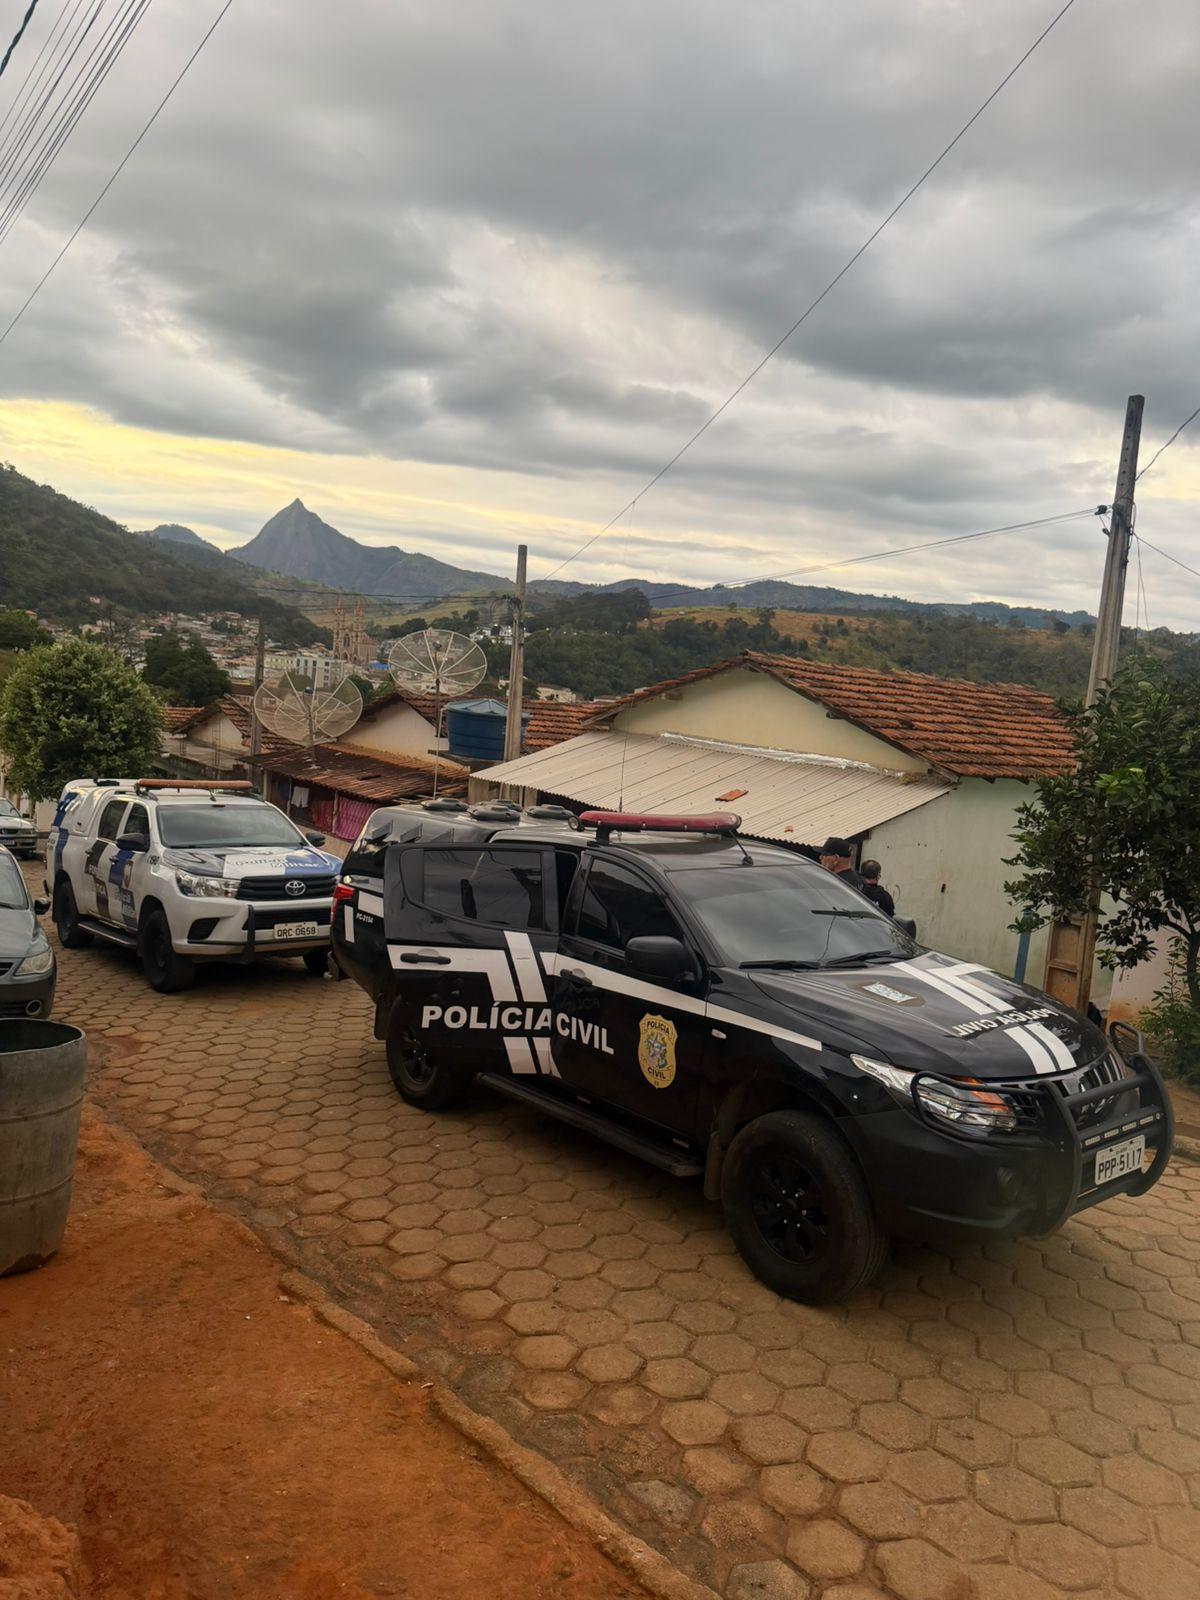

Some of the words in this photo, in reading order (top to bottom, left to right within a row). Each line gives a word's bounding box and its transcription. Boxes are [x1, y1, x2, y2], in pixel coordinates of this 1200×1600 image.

[421, 1002, 552, 1030] POLÍCIA
[556, 1012, 614, 1055] CIVIL
[647, 1066, 666, 1079] CIVIL
